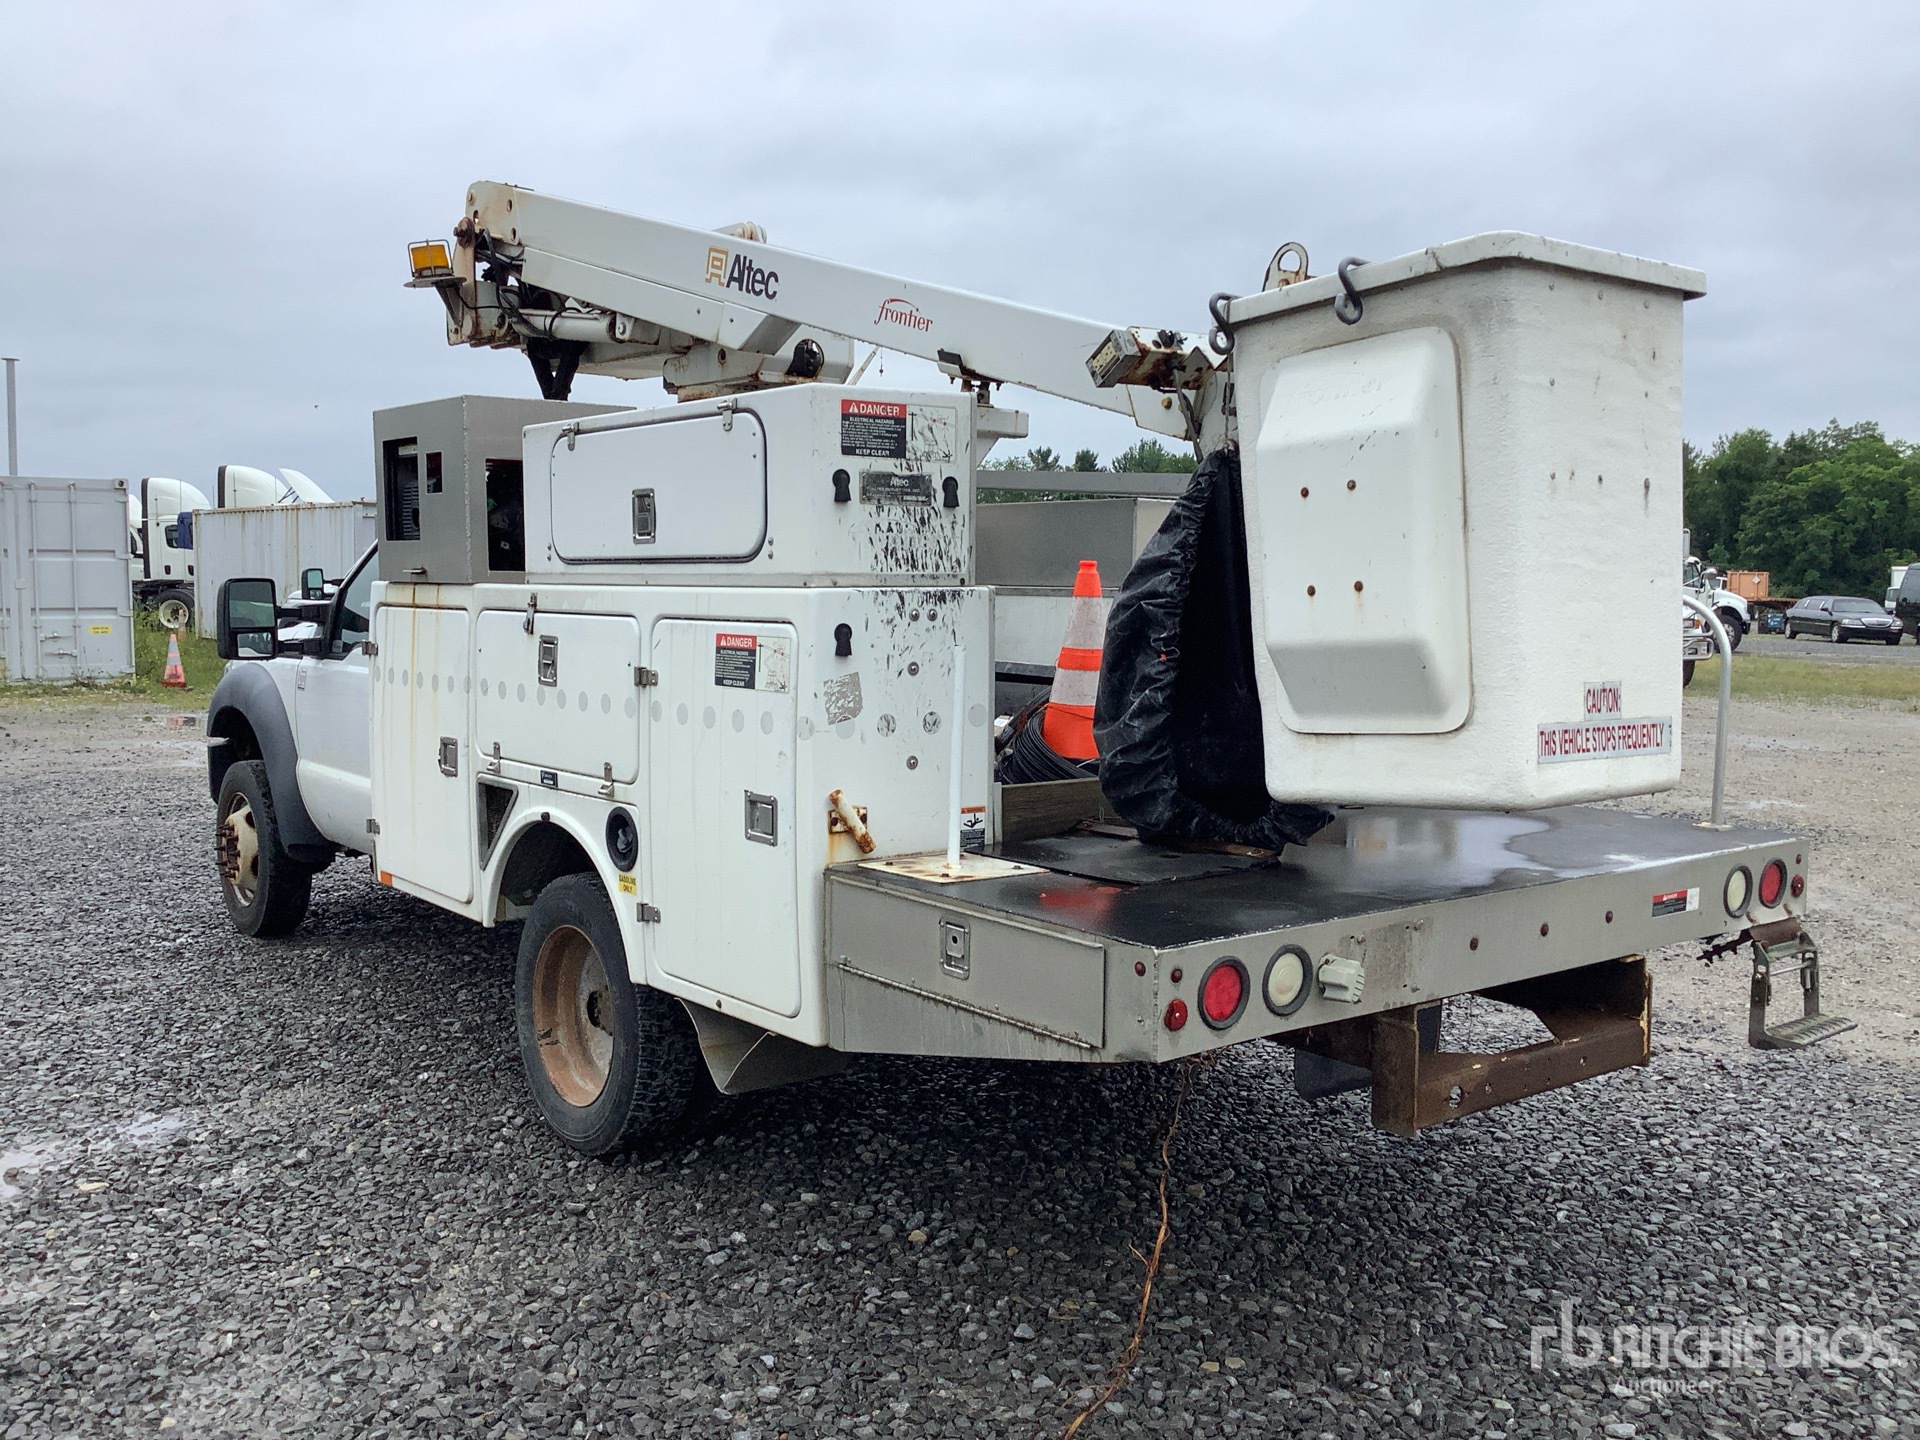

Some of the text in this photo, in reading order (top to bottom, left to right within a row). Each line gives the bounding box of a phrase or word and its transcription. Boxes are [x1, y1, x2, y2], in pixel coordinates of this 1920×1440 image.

[726, 254, 779, 300] Altec
[874, 298, 933, 333] frontier
[860, 404, 900, 416] DANGER
[727, 637, 753, 647] DANGER
[1540, 723, 1664, 757] THIS VEHICLE STOPS FREQUENTLY
